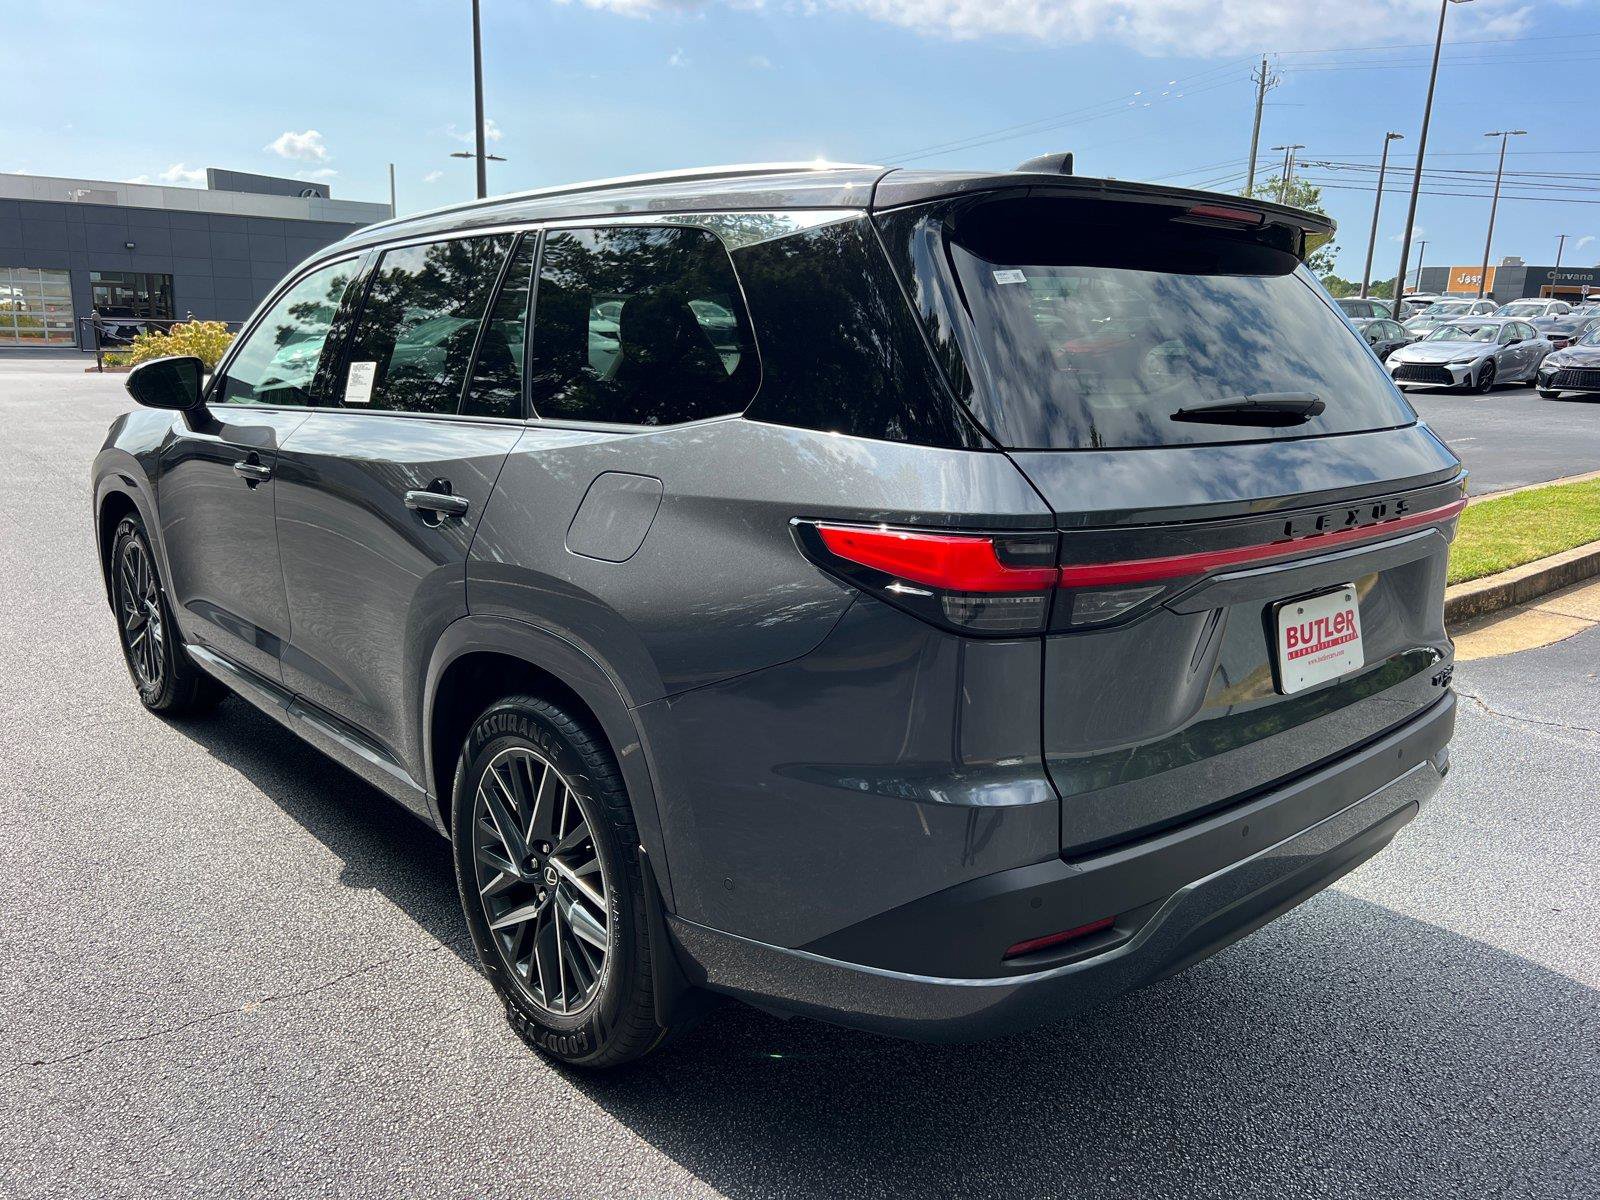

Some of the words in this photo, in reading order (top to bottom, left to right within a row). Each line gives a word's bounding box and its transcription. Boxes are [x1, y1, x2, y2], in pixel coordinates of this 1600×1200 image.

[1456, 273, 1482, 286] Jeep
[1546, 270, 1594, 281] Carvana
[1283, 498, 1411, 537] LEXUS
[476, 712, 563, 762] ASSURANCE
